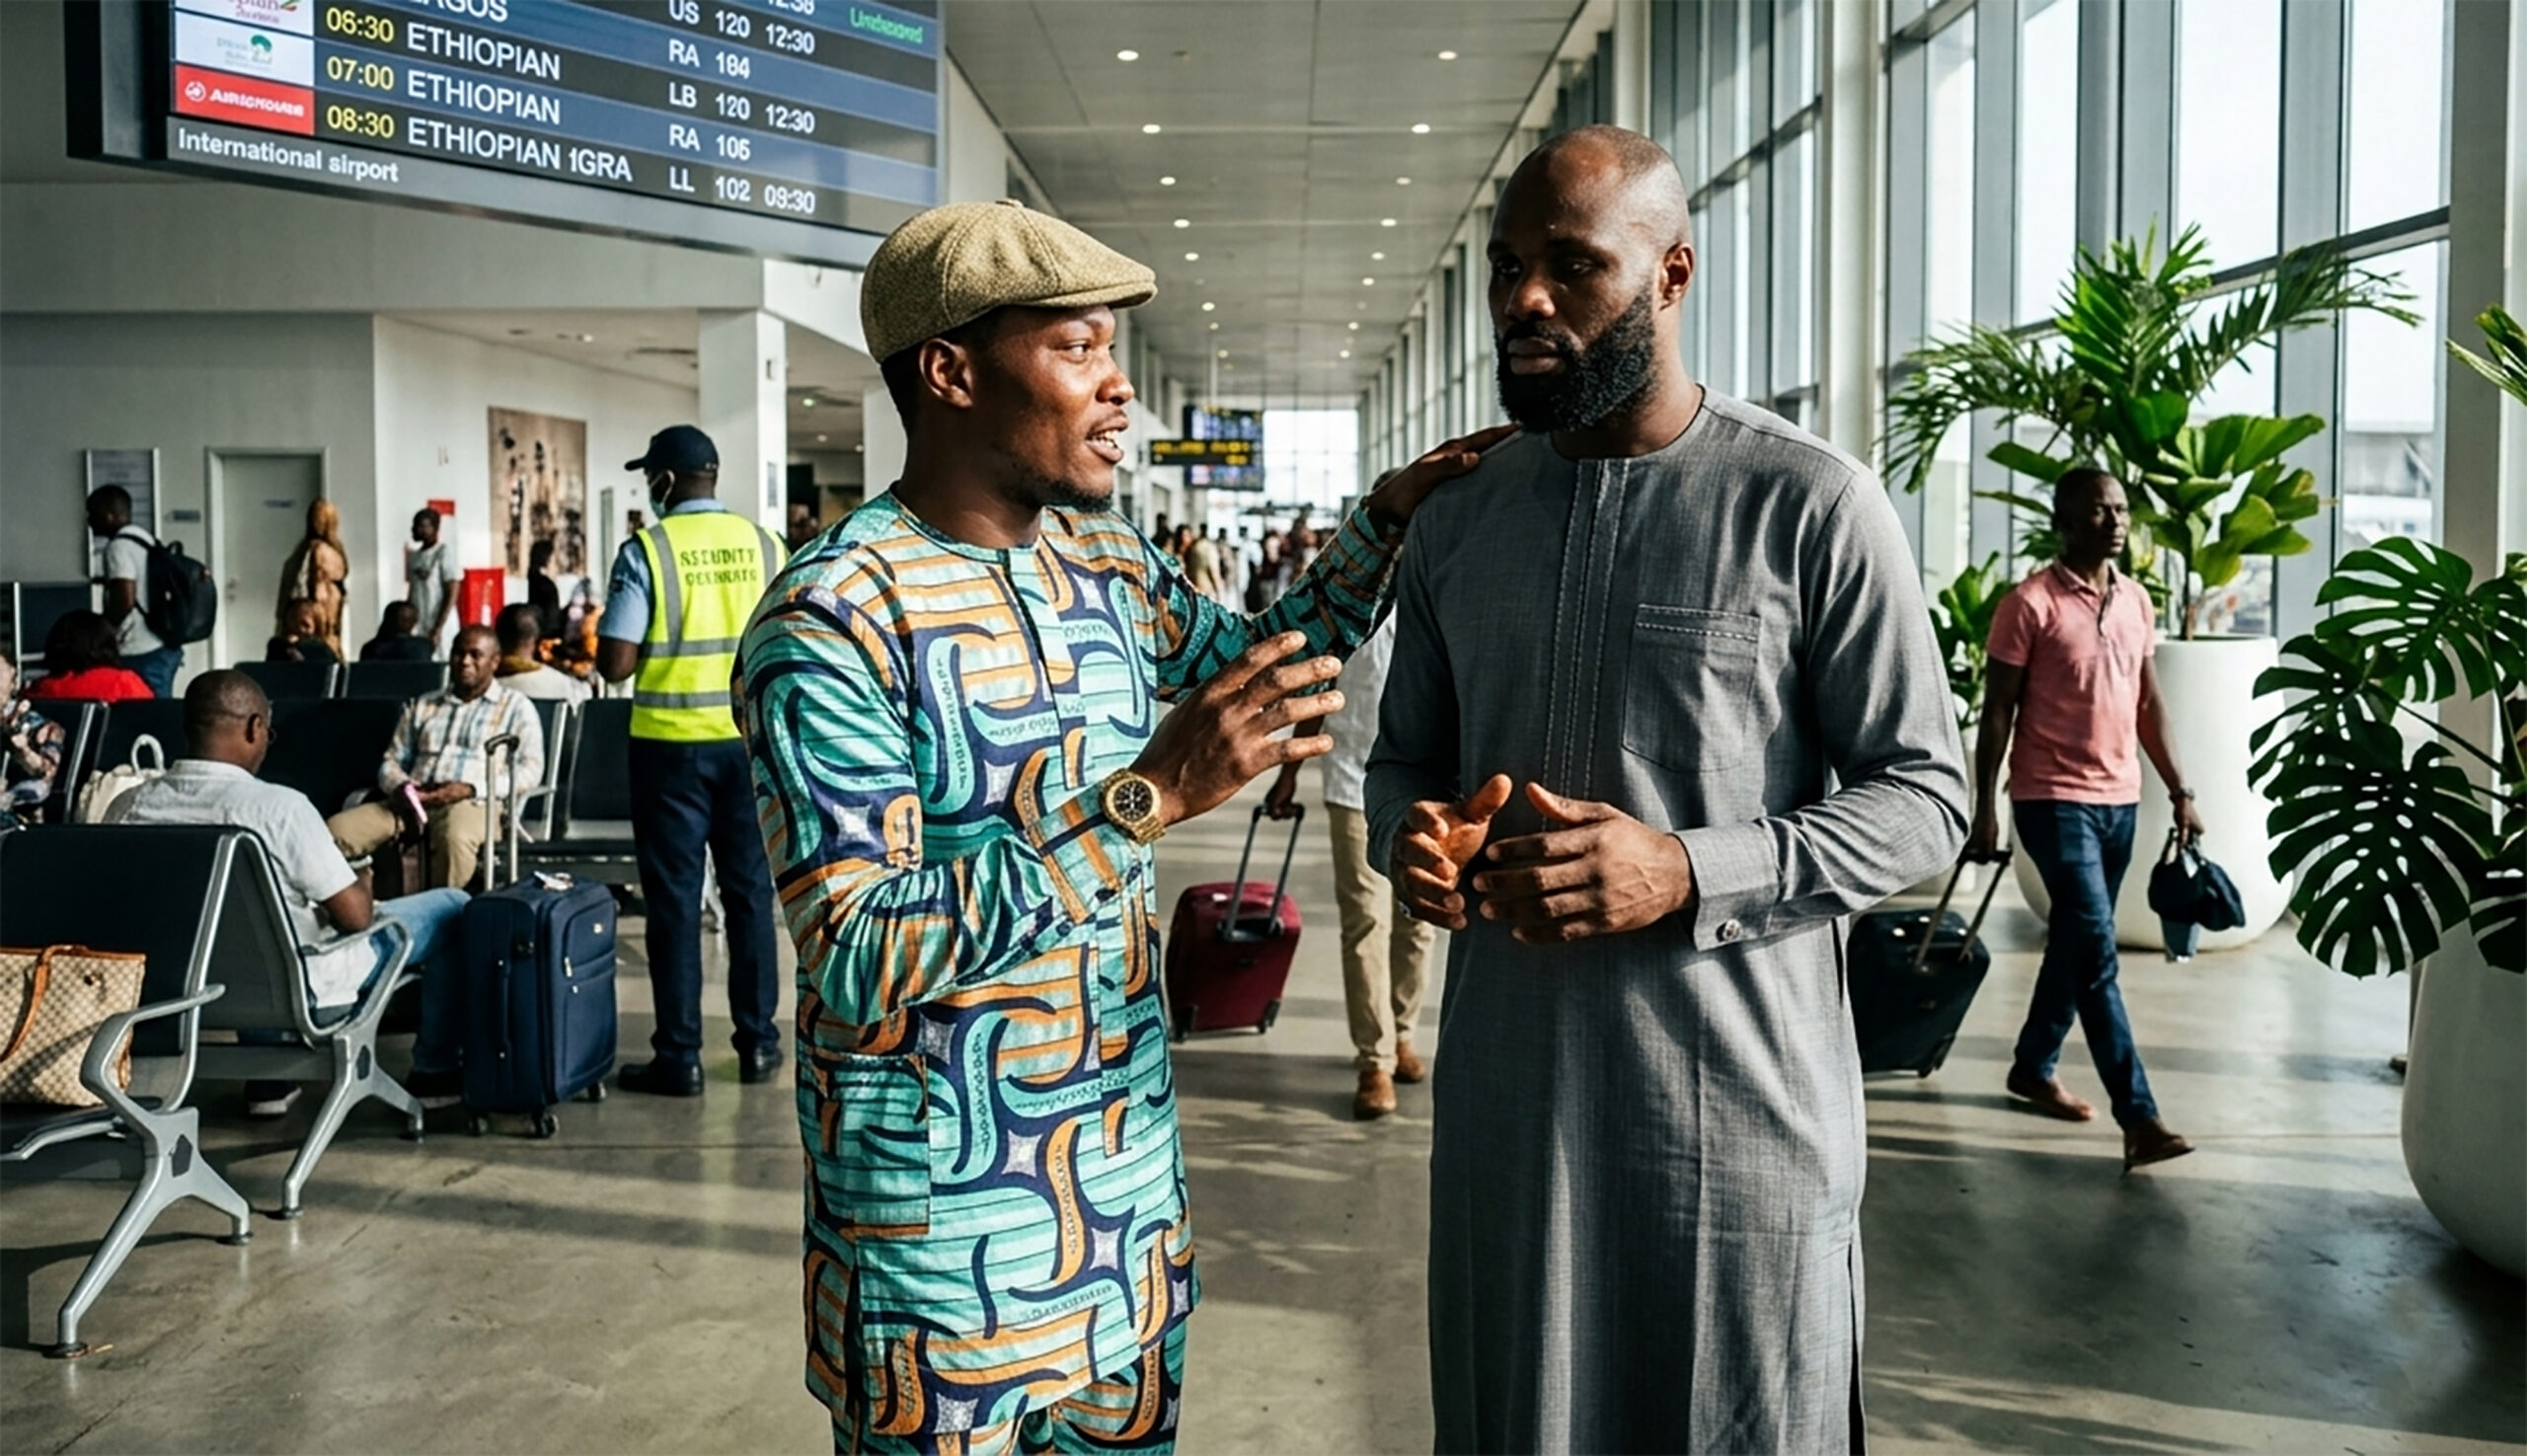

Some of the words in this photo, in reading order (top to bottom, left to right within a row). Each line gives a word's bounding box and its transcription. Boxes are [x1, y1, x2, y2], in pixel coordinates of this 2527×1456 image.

[668, 38, 701, 68] RA
[715, 50, 751, 80] 184
[669, 0, 701, 25] US
[715, 10, 751, 38] 120
[765, 23, 815, 54] 12:30
[326, 7, 395, 42] 06:30
[407, 22, 561, 81] ETHIOPIAN
[668, 81, 697, 110] LB
[715, 92, 751, 121] 120
[765, 104, 815, 134] 12:30
[326, 55, 395, 91] 07:00
[407, 69, 561, 125] ETHIOPIAN
[668, 123, 702, 152] RA
[178, 127, 323, 170] International
[327, 105, 395, 139] 08:30
[408, 117, 562, 170] ETHIOPIAN
[668, 165, 696, 193] LL
[715, 175, 751, 202] 102
[764, 184, 815, 214] 09:30
